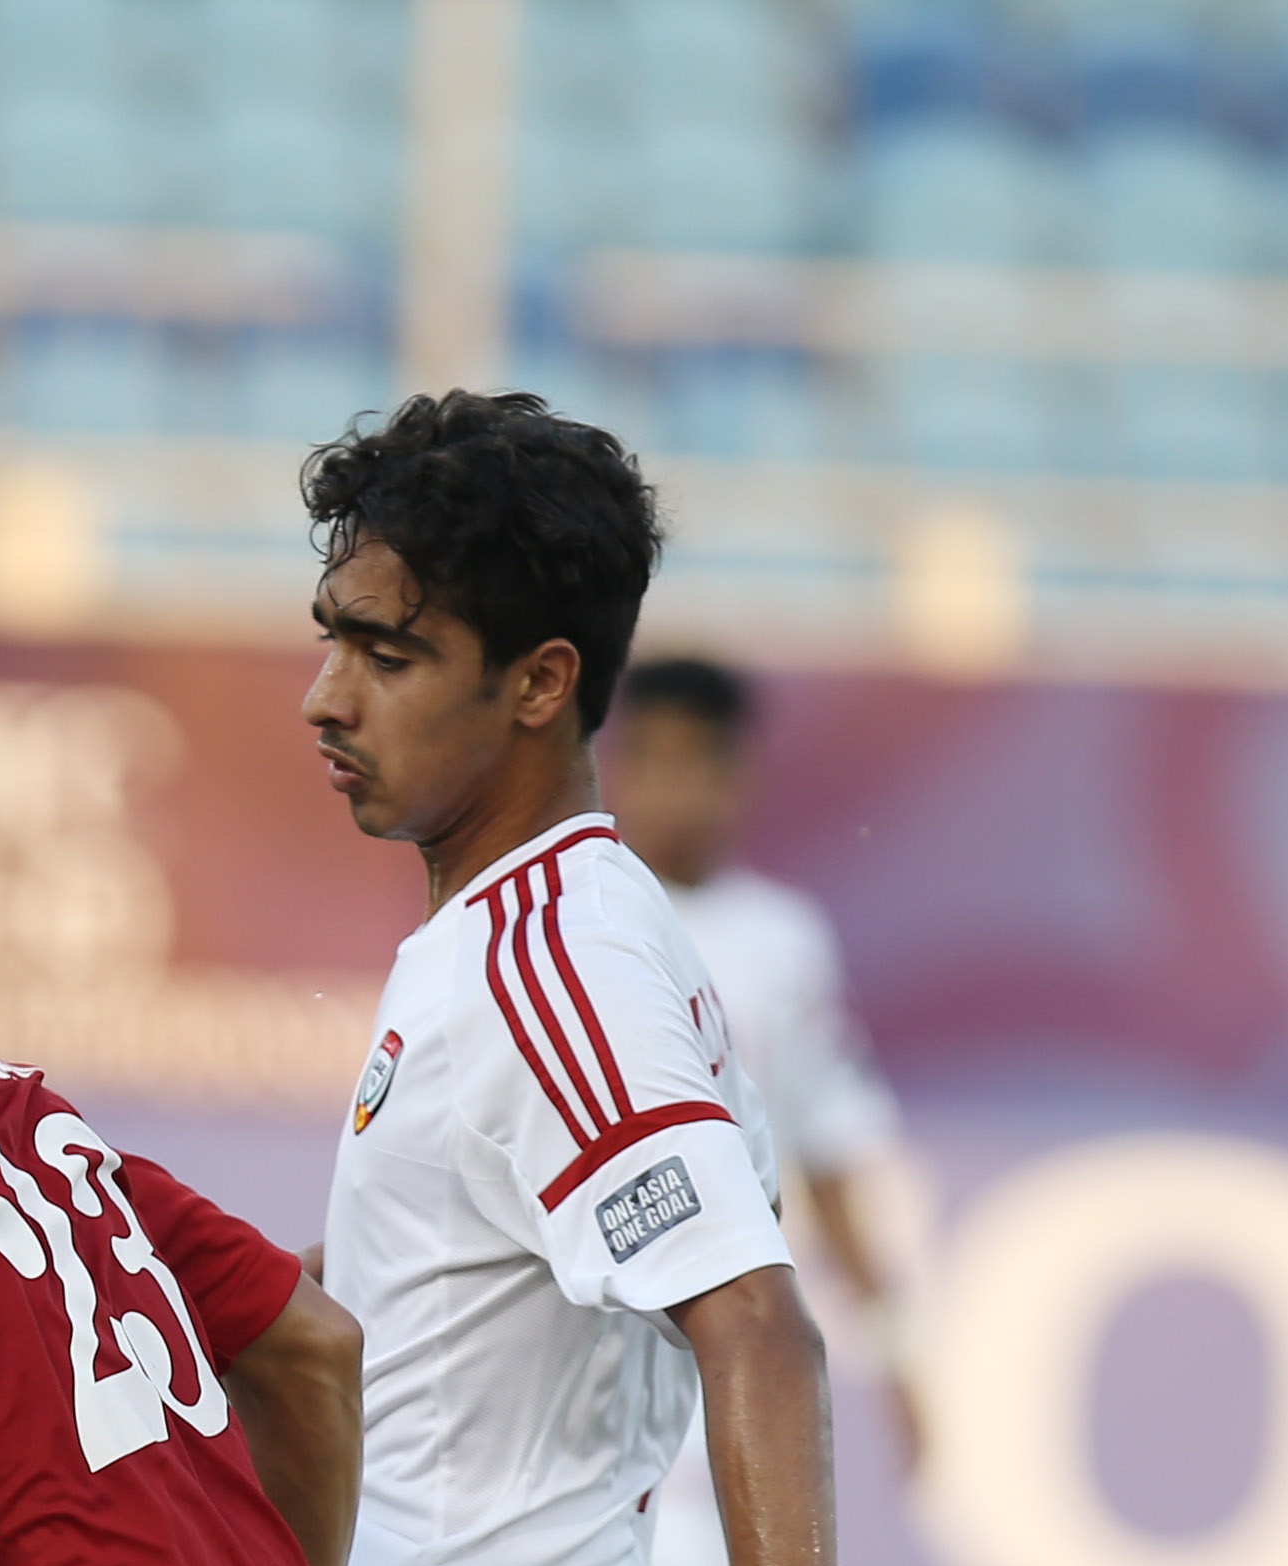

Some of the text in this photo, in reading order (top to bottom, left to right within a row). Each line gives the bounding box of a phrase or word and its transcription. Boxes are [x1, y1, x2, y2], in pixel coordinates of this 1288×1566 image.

[602, 1168, 683, 1231] ONE ASIA
[610, 1188, 695, 1252] ONE GOAL
